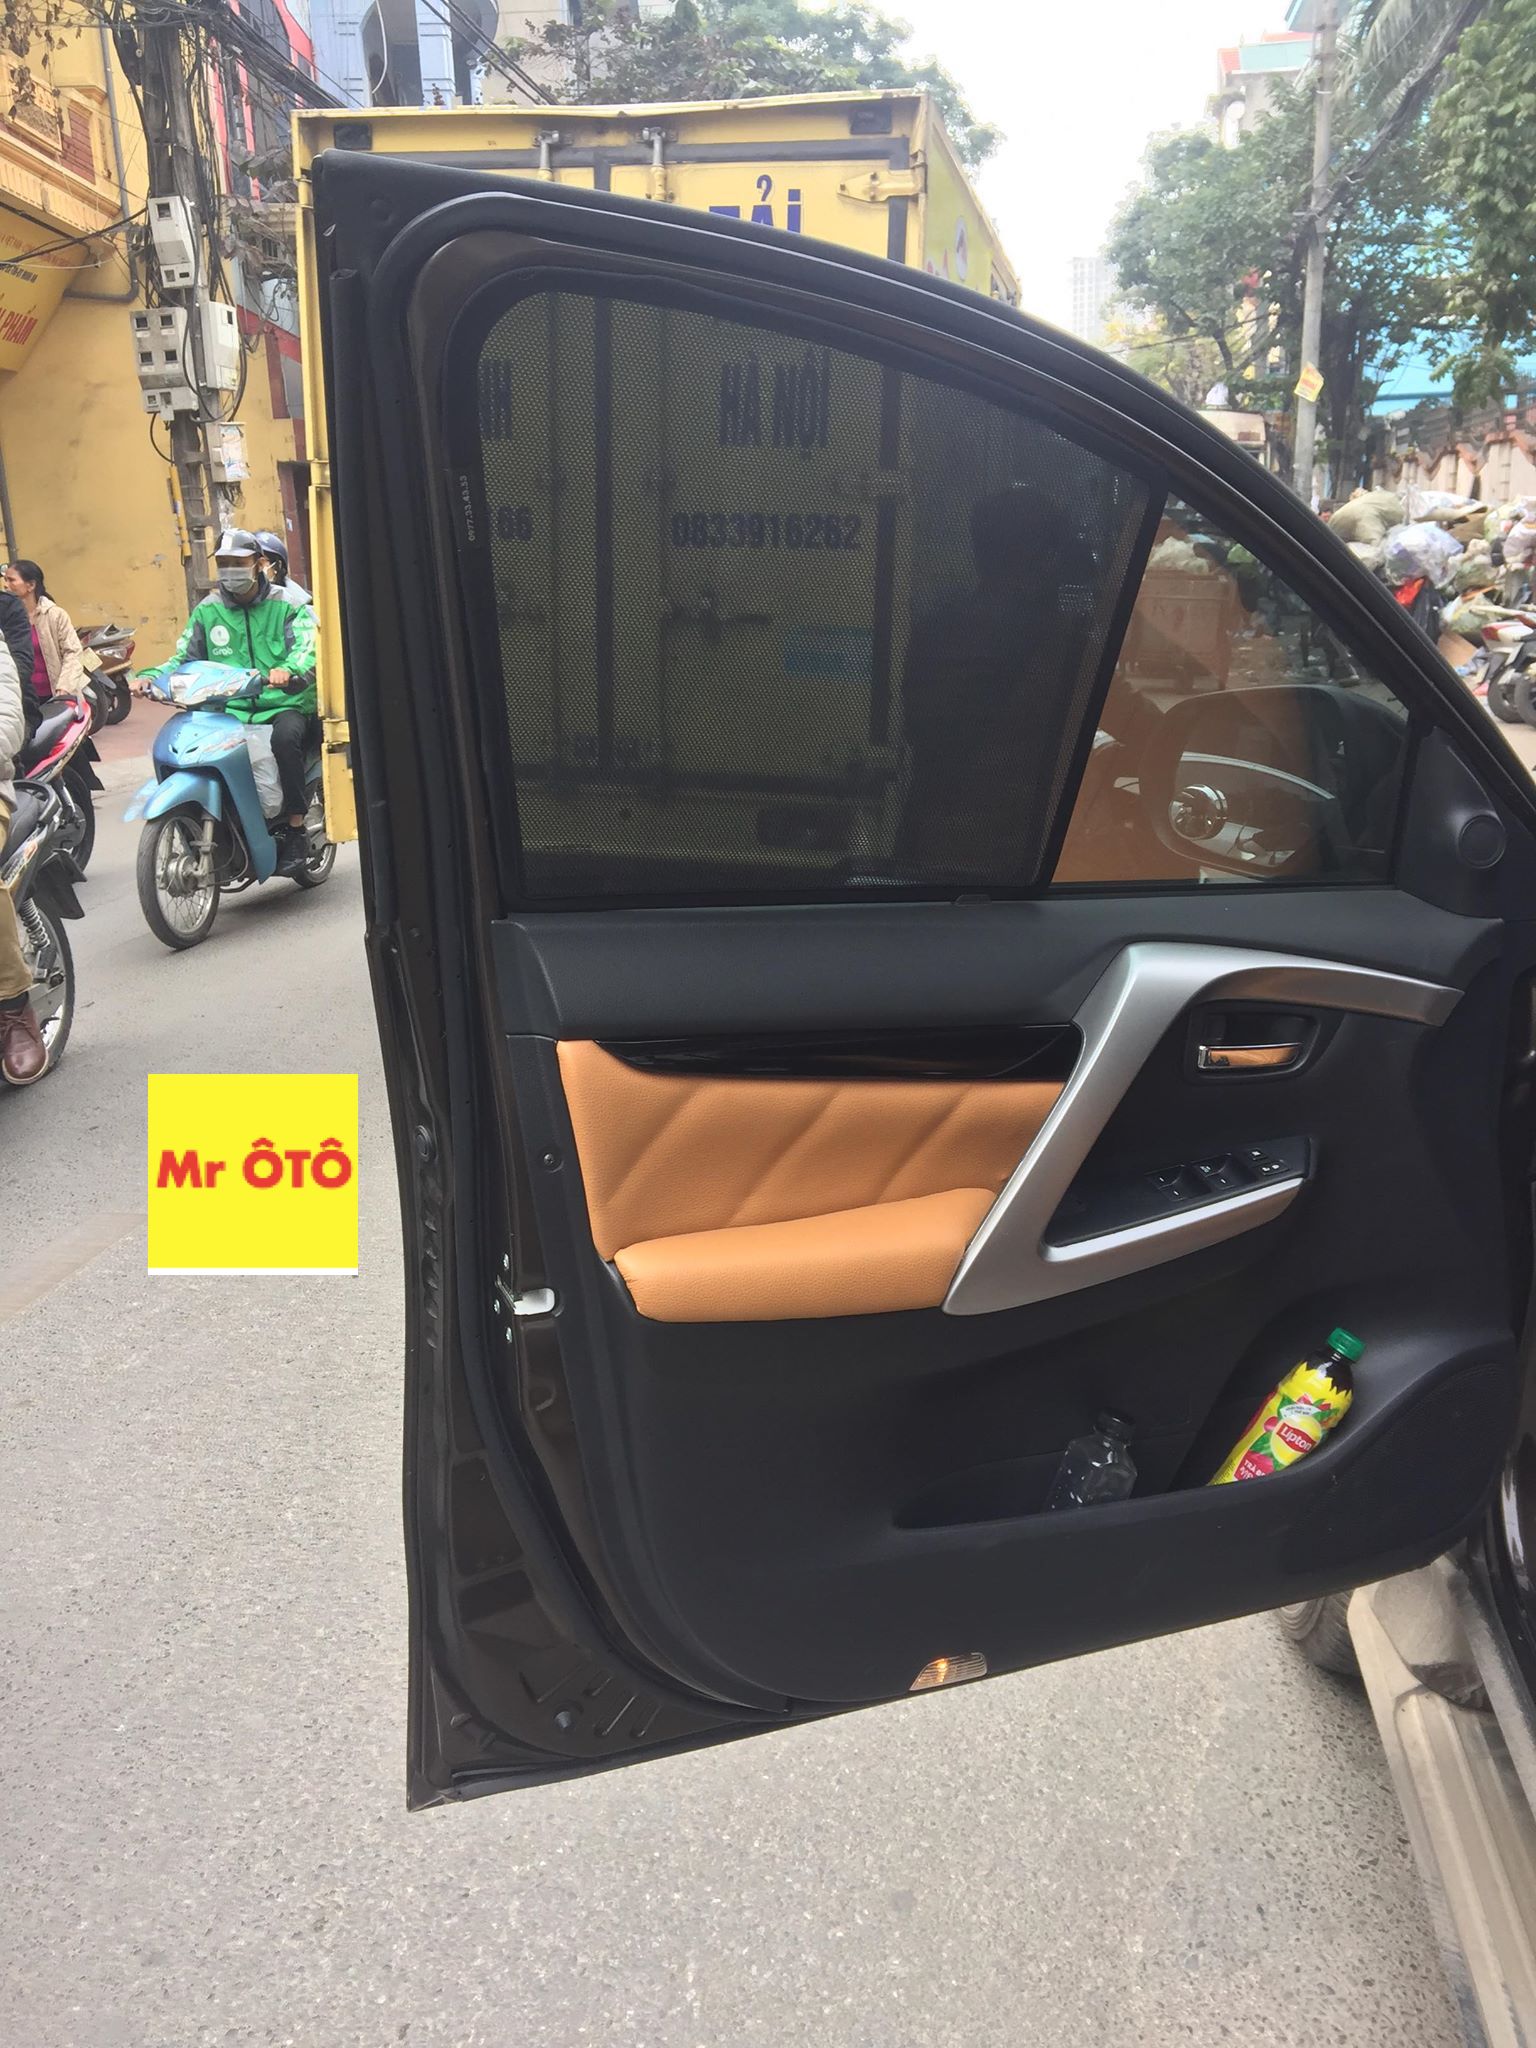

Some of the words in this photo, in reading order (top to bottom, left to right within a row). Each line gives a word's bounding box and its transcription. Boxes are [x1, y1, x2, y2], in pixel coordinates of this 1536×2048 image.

[720, 349, 762, 447] HÀ
[212, 646, 234, 656] Grab
[1280, 1426, 1313, 1452] Lipton
[1244, 1460, 1258, 1474] TRÀ
